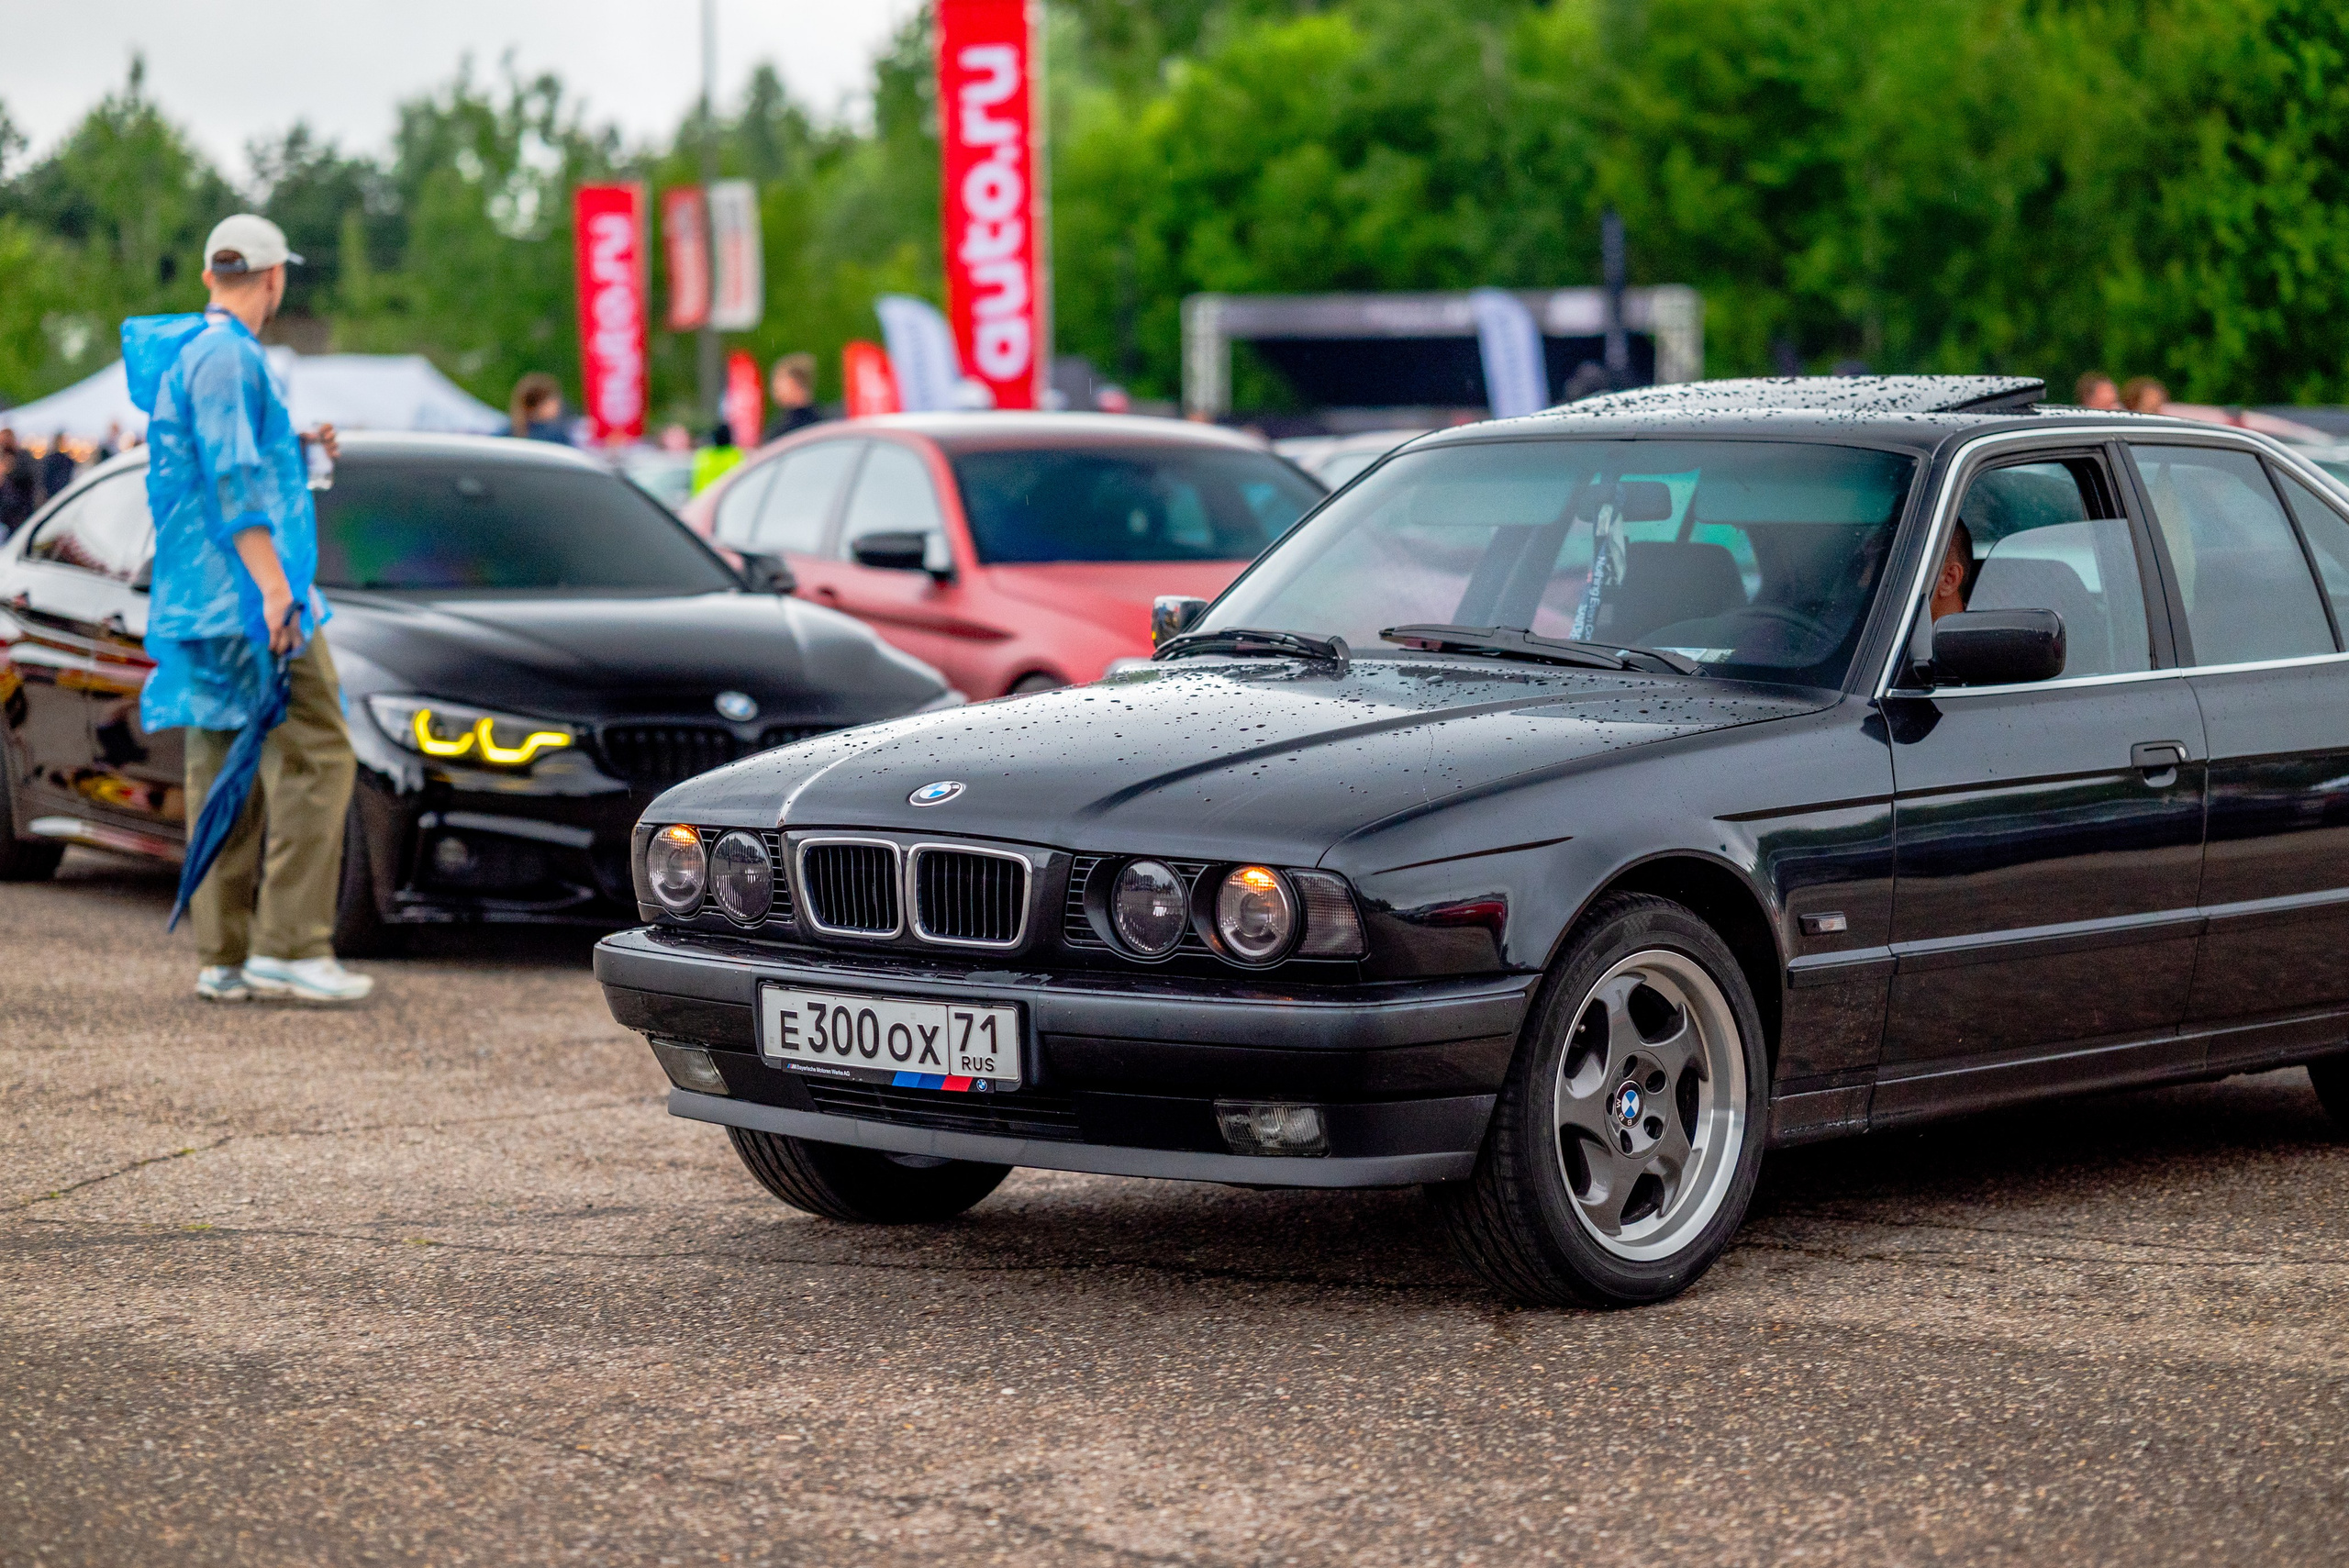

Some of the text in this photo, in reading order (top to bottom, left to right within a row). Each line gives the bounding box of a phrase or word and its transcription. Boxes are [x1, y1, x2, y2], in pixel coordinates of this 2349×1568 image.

[958, 42, 1030, 381] auto.ru
[954, 1012, 997, 1053] 71
[962, 1055, 996, 1072] RUS
[1616, 1098, 1632, 1126] BMW
